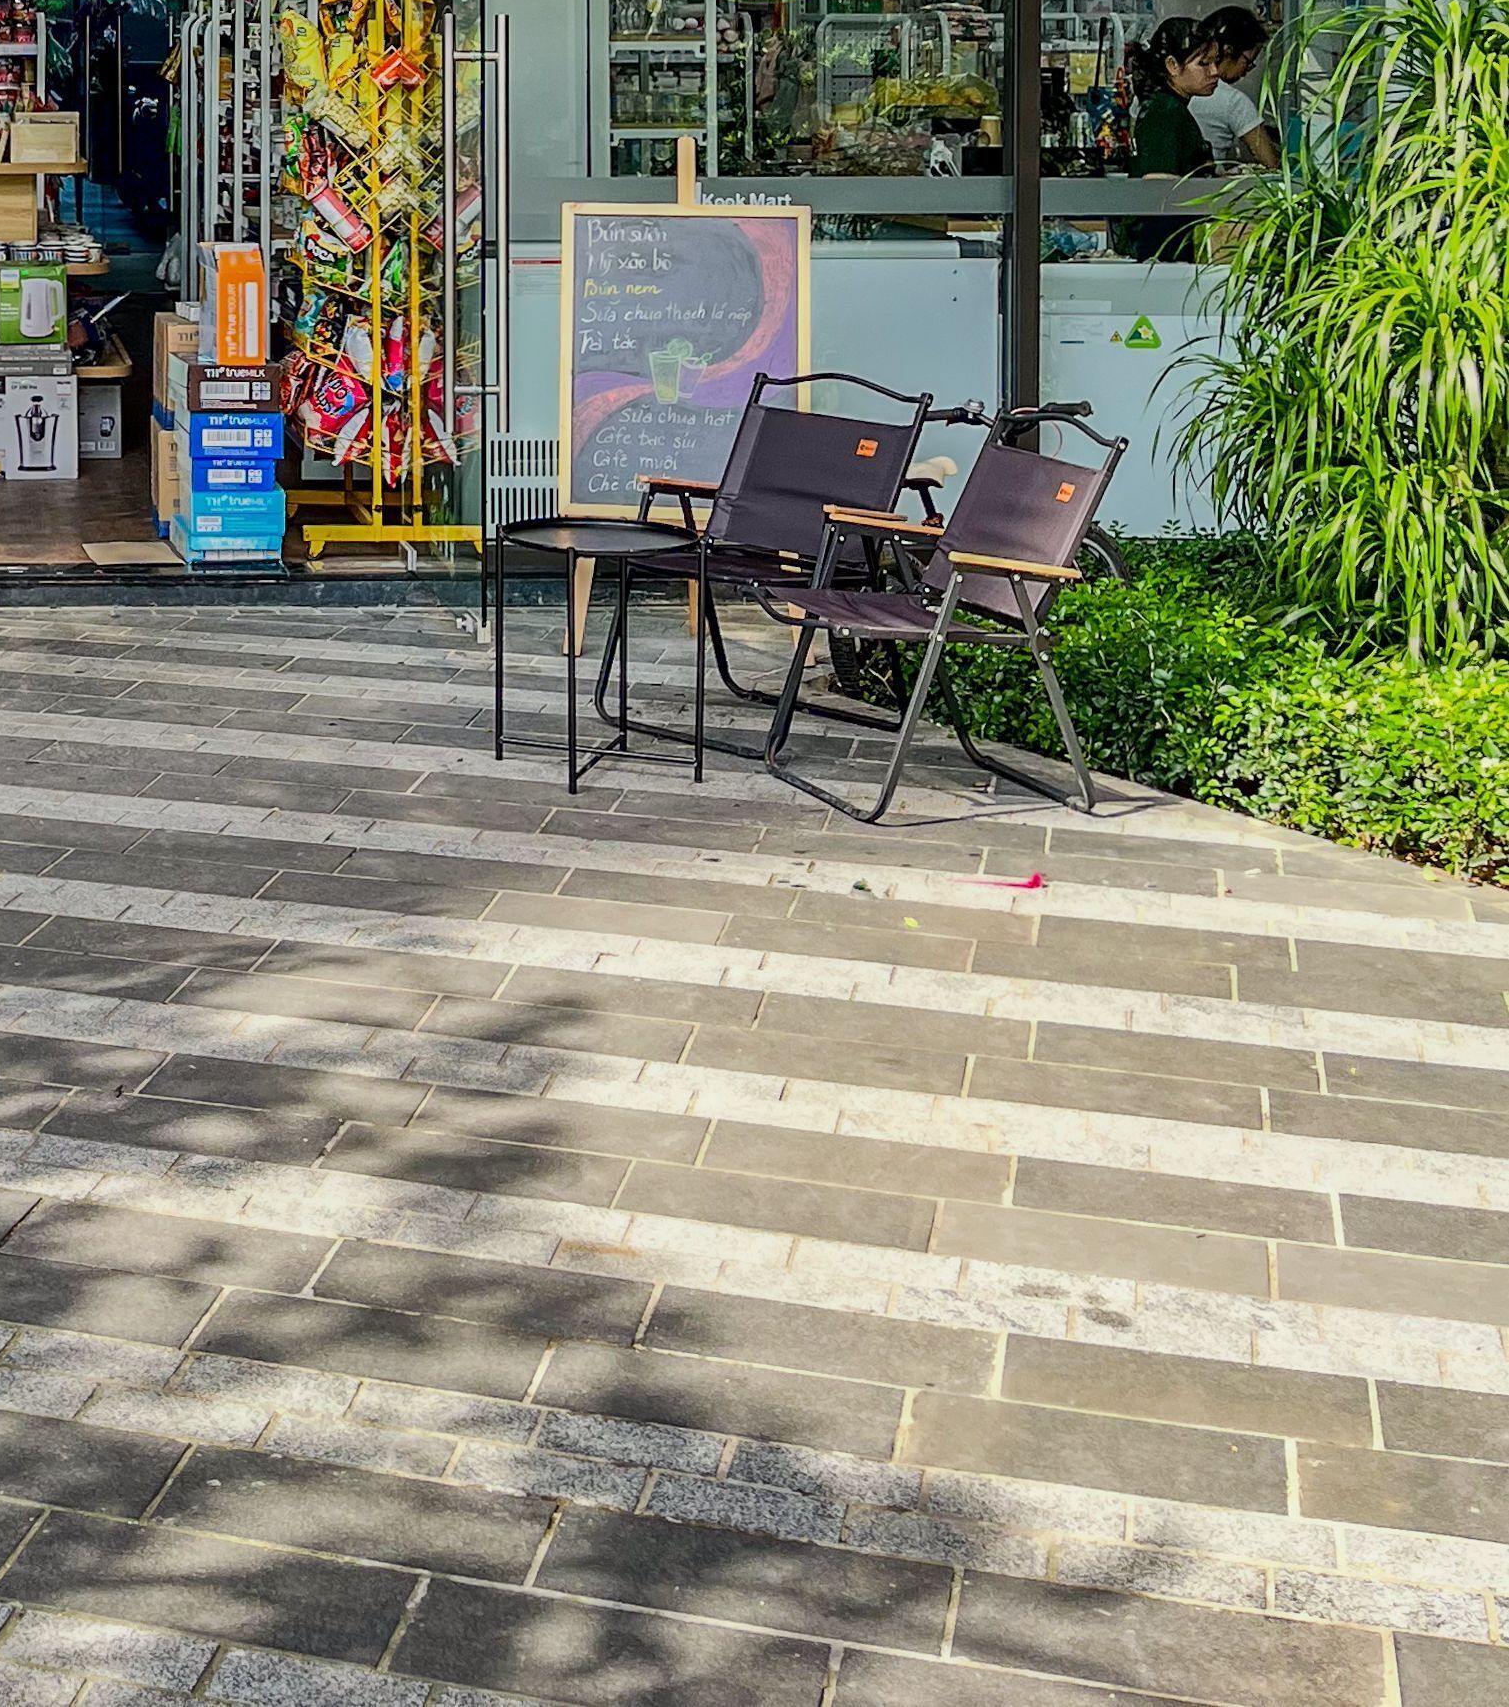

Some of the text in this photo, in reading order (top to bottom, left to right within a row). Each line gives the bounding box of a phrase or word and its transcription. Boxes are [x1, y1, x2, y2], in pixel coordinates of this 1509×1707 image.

[749, 192, 792, 206] Mart
[588, 220, 625, 246] Bún
[583, 278, 662, 298] Bún nem
[624, 303, 662, 321] chua
[579, 329, 603, 354] Trà
[658, 406, 696, 425] chua
